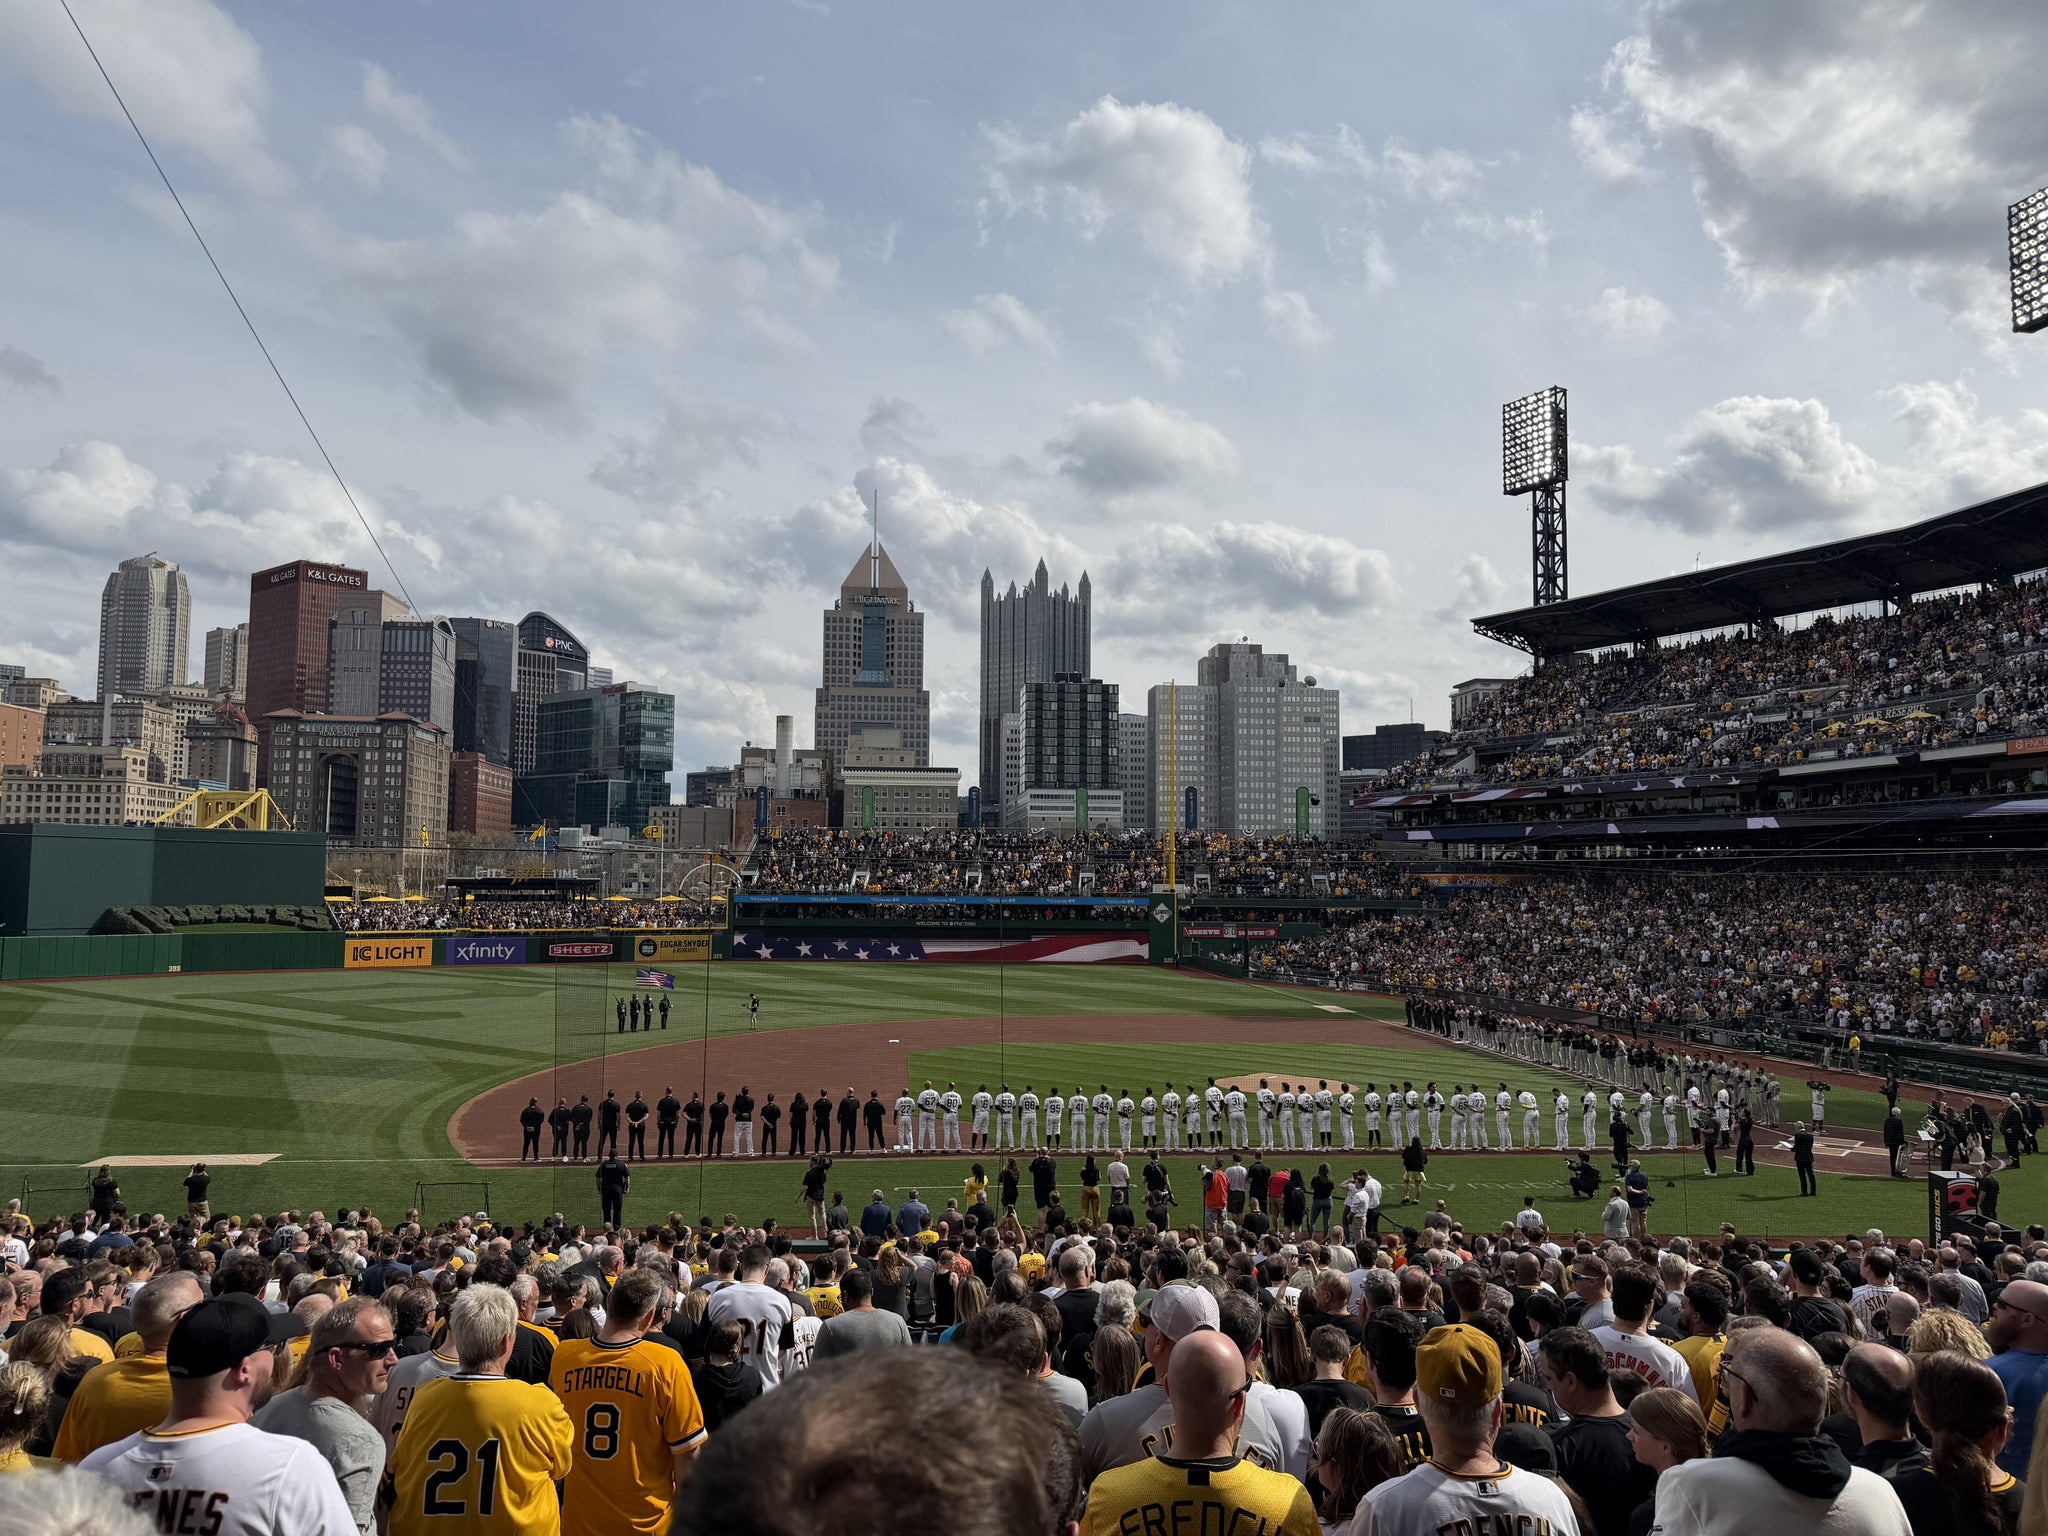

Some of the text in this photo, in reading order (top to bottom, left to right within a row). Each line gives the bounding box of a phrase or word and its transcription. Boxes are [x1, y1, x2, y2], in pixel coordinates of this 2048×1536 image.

[280, 569, 296, 581] GATES
[307, 569, 361, 586] K&L GATES
[493, 621, 507, 630] PNC
[555, 639, 573, 651] PNC
[2024, 738, 2042, 748] PNC
[651, 827, 659, 837] P
[553, 869, 579, 878] TIME
[1457, 875, 1493, 886] Surfside
[553, 945, 608, 953] SHEETZ
[660, 940, 682, 948] EDGAR
[375, 946, 425, 959] LIGHT
[456, 943, 515, 960] xfinity
[924, 1097, 936, 1106] 67
[946, 1099, 958, 1108] 80
[1024, 1101, 1035, 1110] 88
[1232, 1098, 1241, 1106] 31
[900, 1105, 912, 1114] 27
[1050, 1104, 1060, 1113] 95
[1076, 1103, 1084, 1112] 41
[1934, 1216, 1941, 1231] GO
[4, 1245, 17, 1253] RUZ
[813, 1300, 843, 1316] YNOLDS
[564, 1366, 644, 1399] STARGELL
[583, 1401, 621, 1461] 8
[422, 1438, 500, 1517] 21
